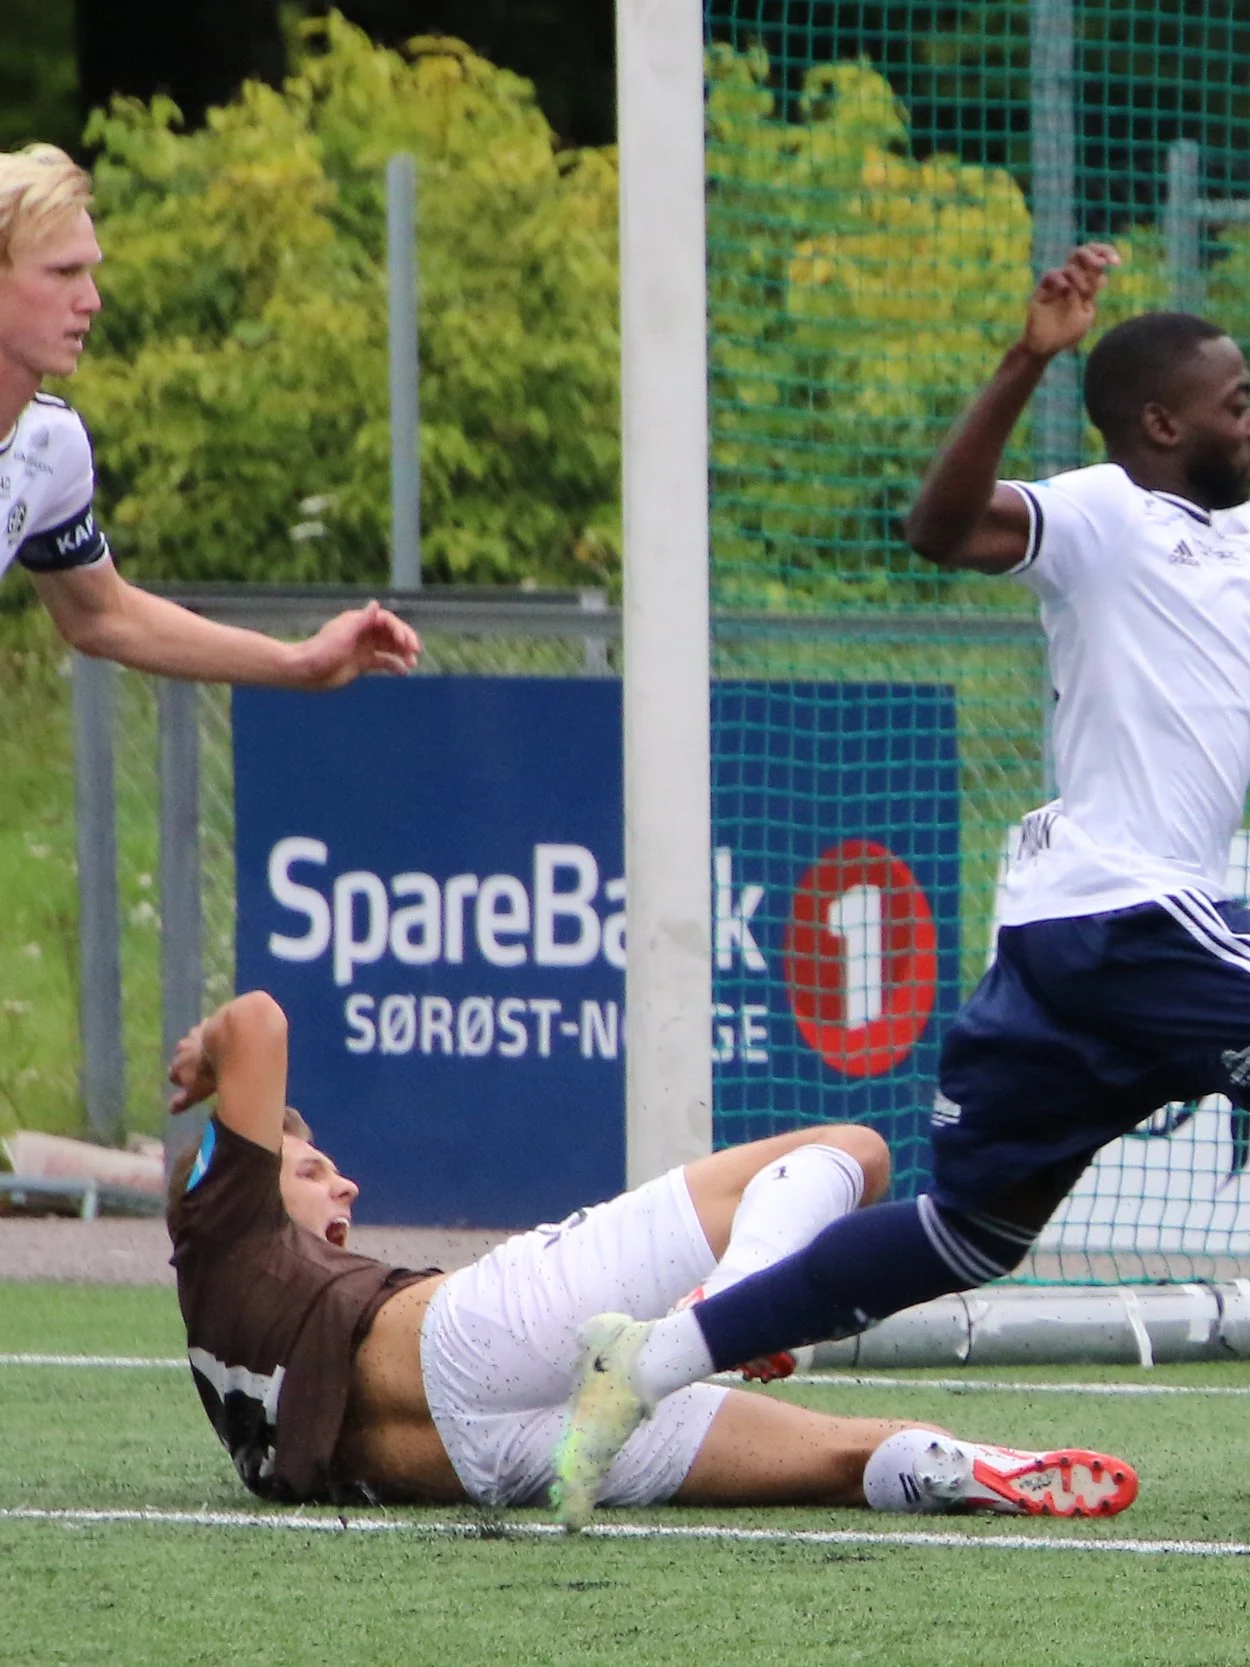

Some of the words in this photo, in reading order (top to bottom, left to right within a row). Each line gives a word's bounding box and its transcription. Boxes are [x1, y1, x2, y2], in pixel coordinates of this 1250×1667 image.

[268, 835, 768, 987] SpareBk
[828, 884, 883, 1030] 1
[345, 993, 769, 1063] SØRØST-NGE
